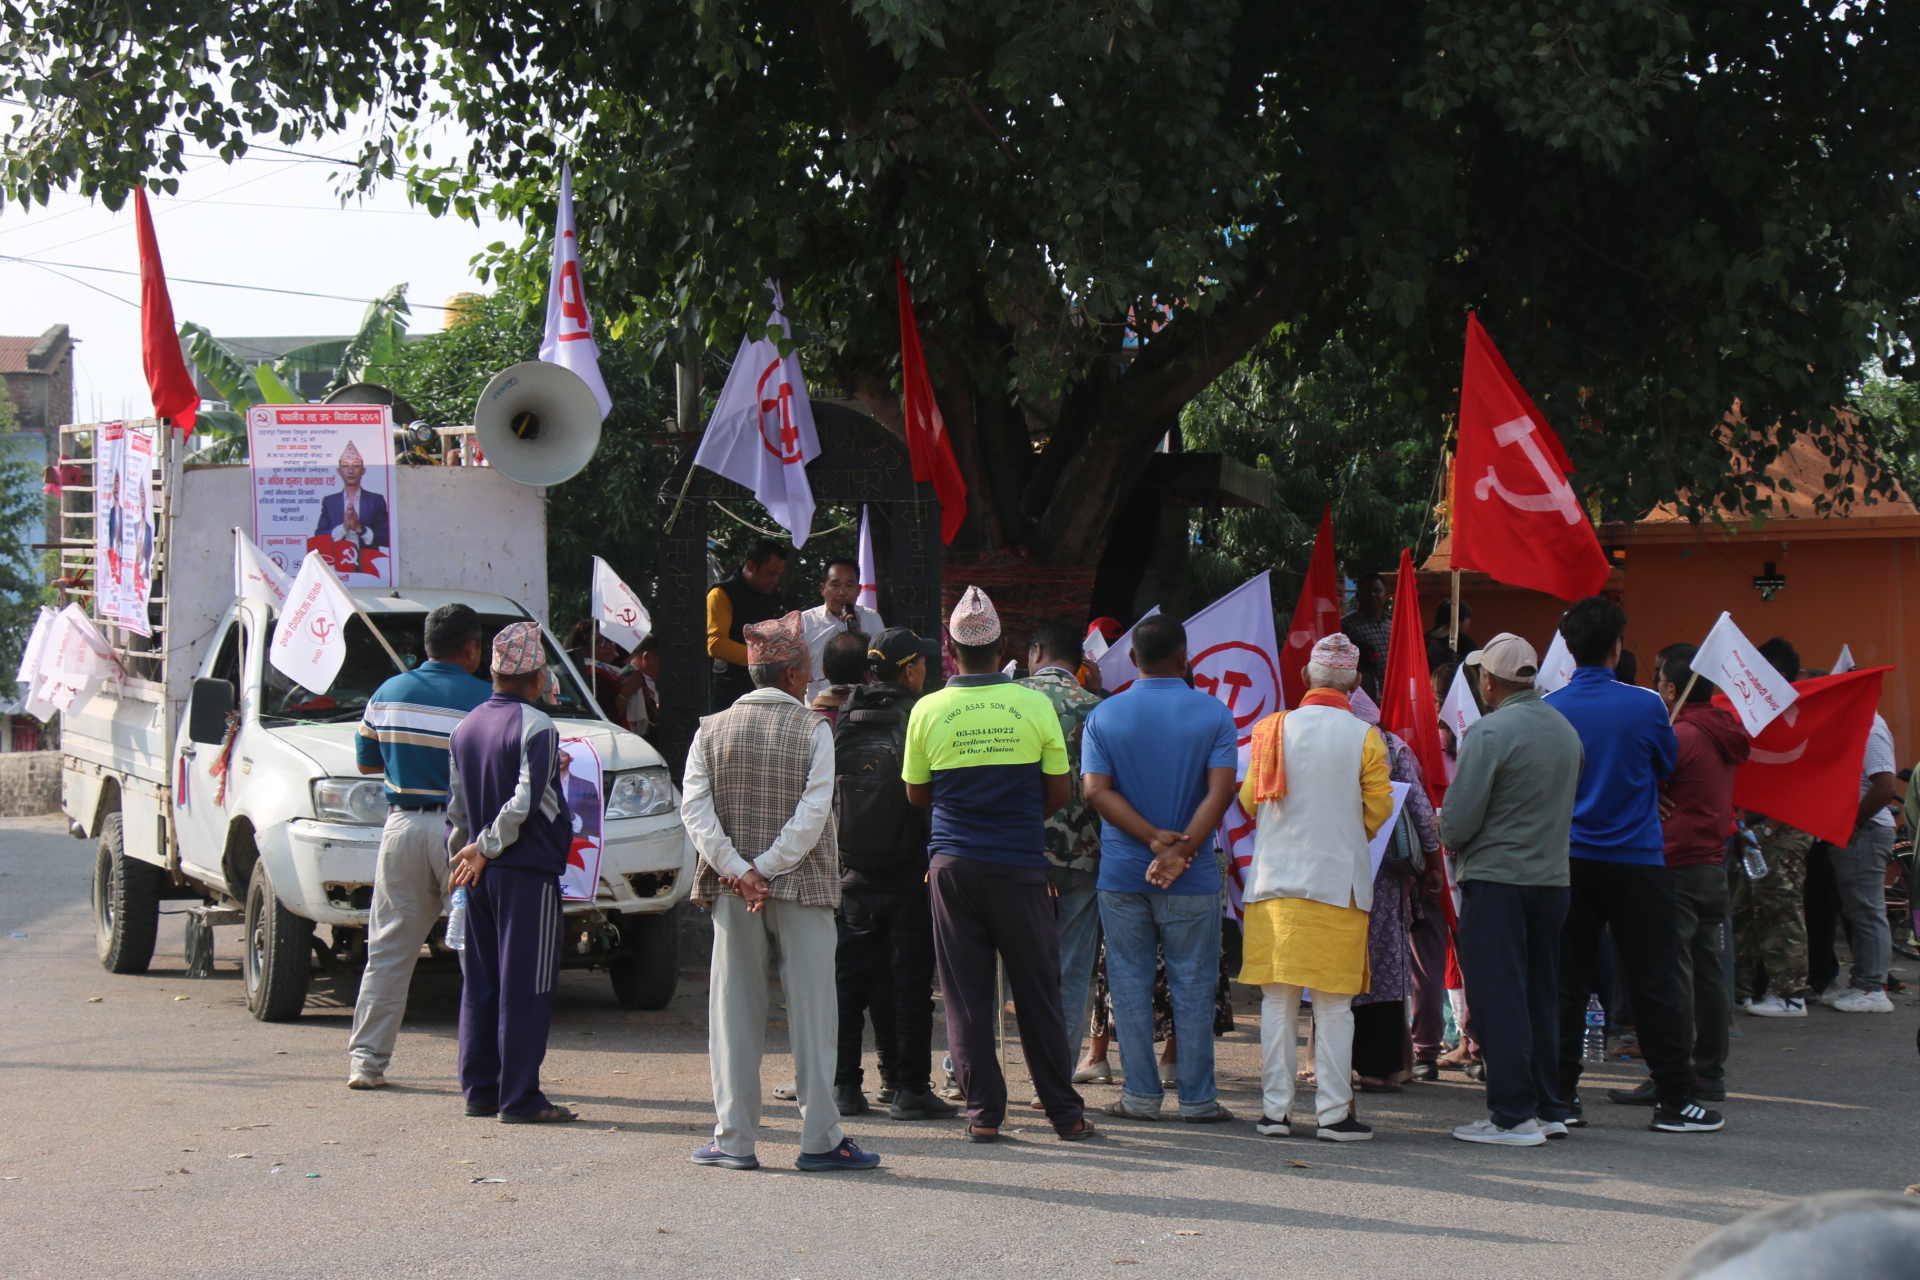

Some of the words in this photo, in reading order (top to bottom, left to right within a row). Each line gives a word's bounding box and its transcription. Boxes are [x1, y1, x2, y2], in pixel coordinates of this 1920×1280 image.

[280, 411, 304, 421] स्थानीय
[306, 413, 317, 421] तह
[334, 411, 358, 421] निर्वाचन
[360, 413, 378, 422] २०८१
[807, 470, 882, 500] दयपुर
[1744, 669, 1768, 696] माओवादी
[1765, 695, 1780, 711] केन्द्र
[944, 708, 961, 724] TOKO
[966, 703, 985, 711] ASAS
[1009, 707, 1022, 720] BHD
[952, 738, 992, 747] Excellence
